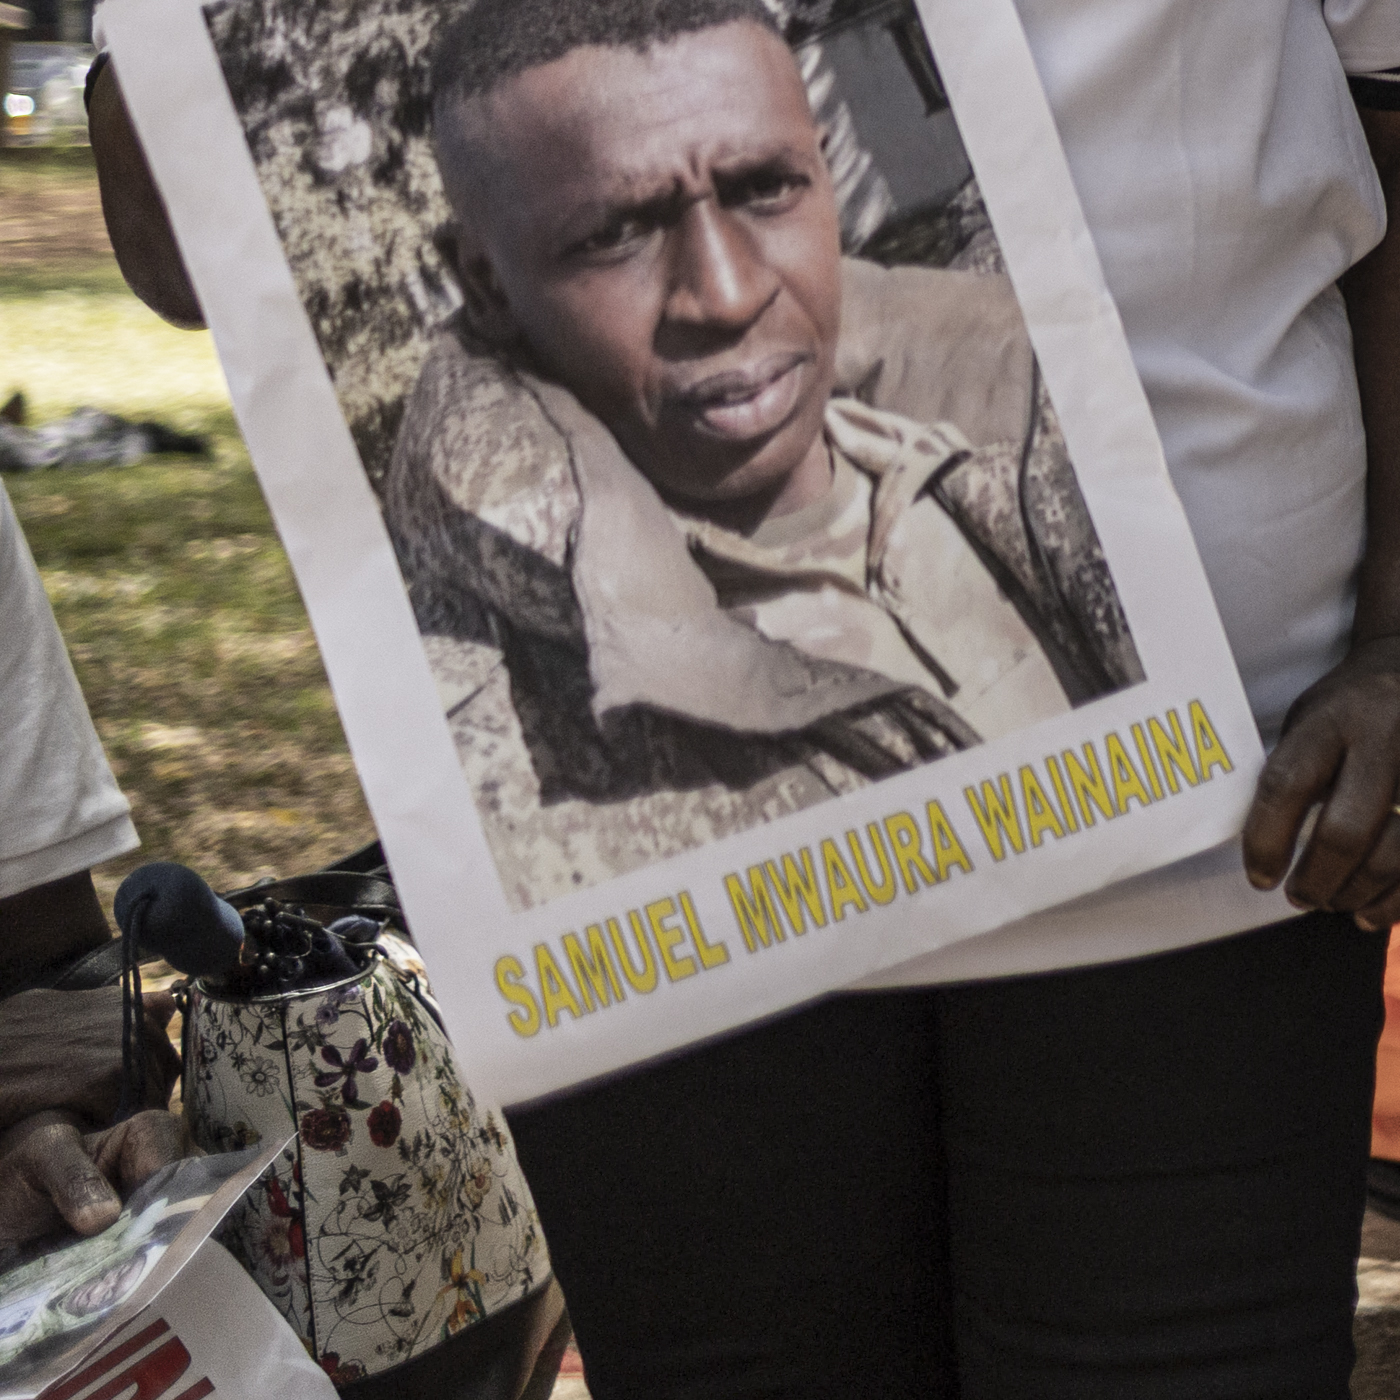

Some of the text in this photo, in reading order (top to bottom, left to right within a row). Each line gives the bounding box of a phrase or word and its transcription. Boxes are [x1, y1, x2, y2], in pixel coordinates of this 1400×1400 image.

[493, 700, 1235, 1038] SAMUEL MWAURA WAINAINA
